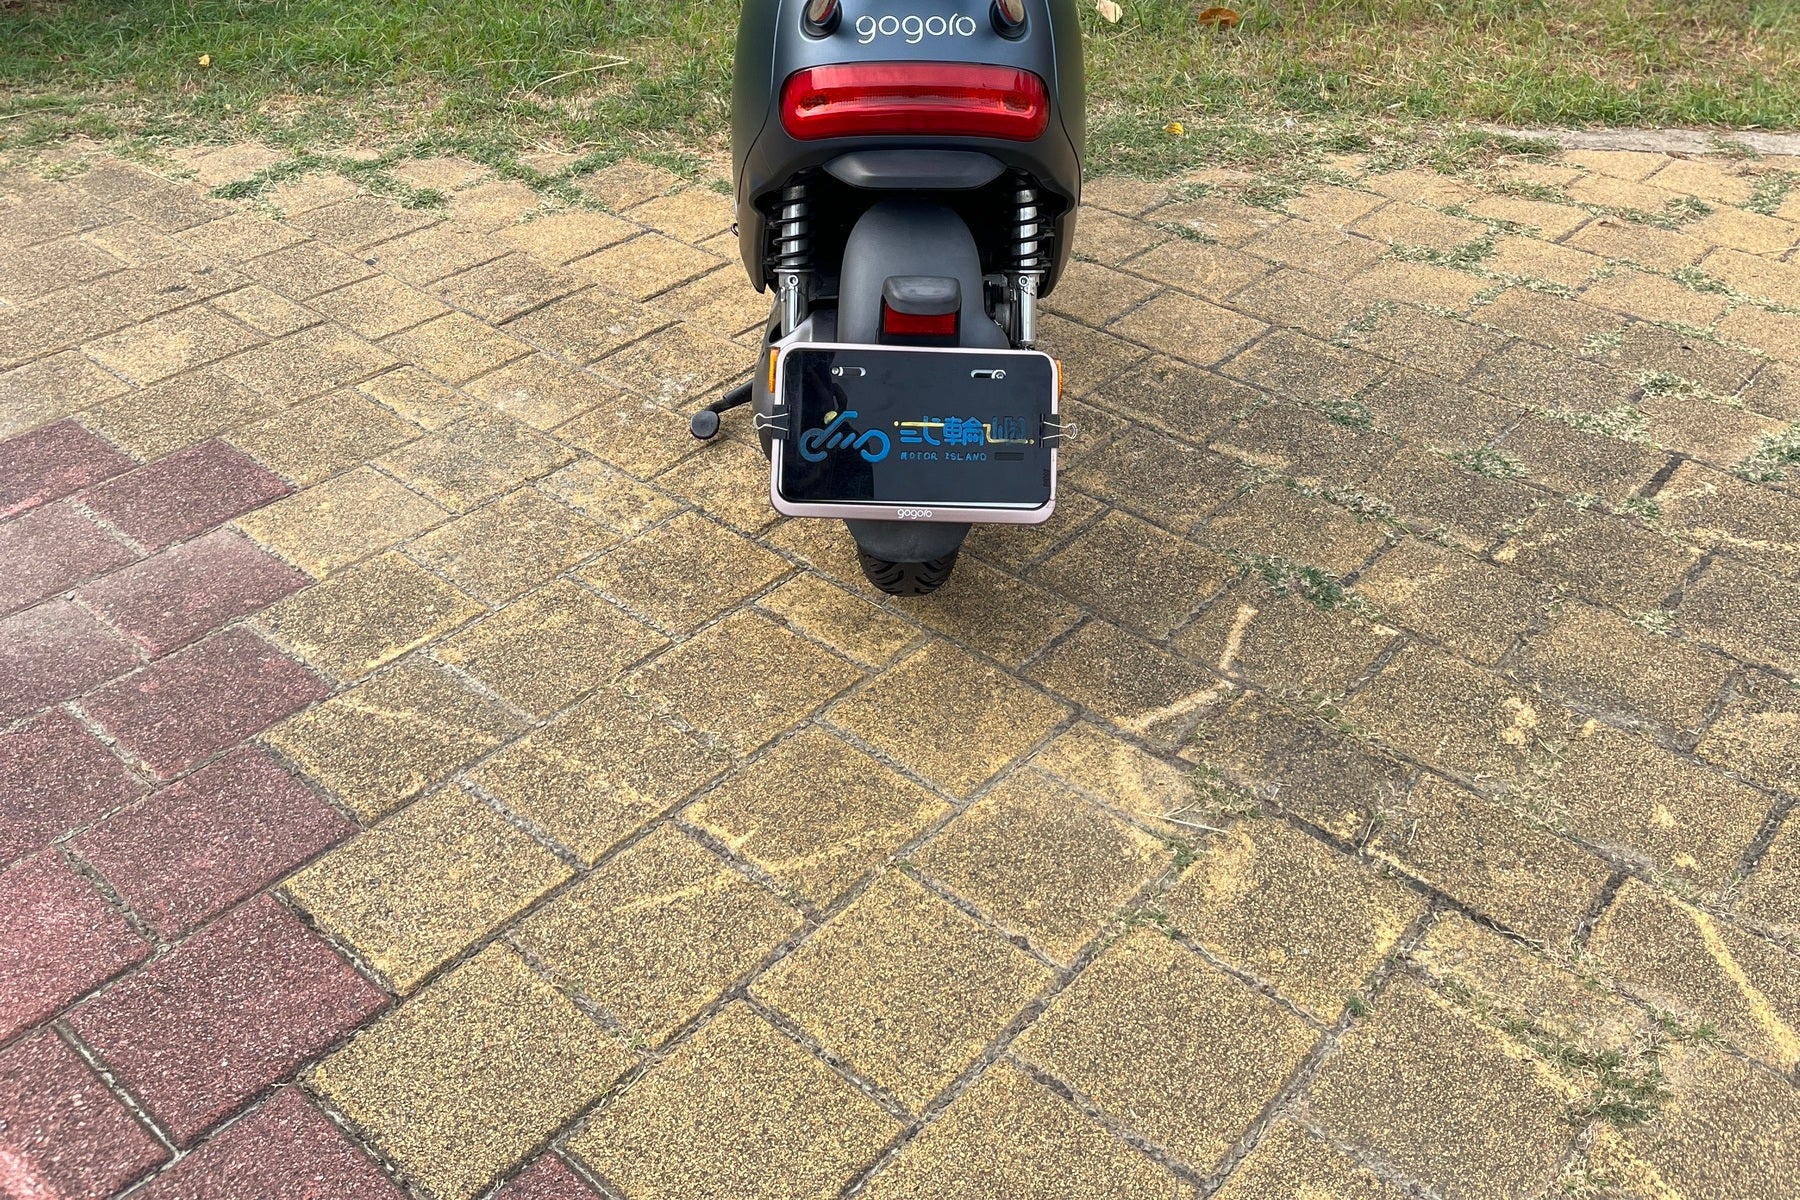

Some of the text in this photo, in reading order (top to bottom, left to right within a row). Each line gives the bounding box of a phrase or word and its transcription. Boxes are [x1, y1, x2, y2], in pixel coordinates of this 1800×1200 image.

[854, 12, 977, 44] gogoro
[900, 451, 938, 461] MOTOR
[897, 508, 933, 519] gogoro
